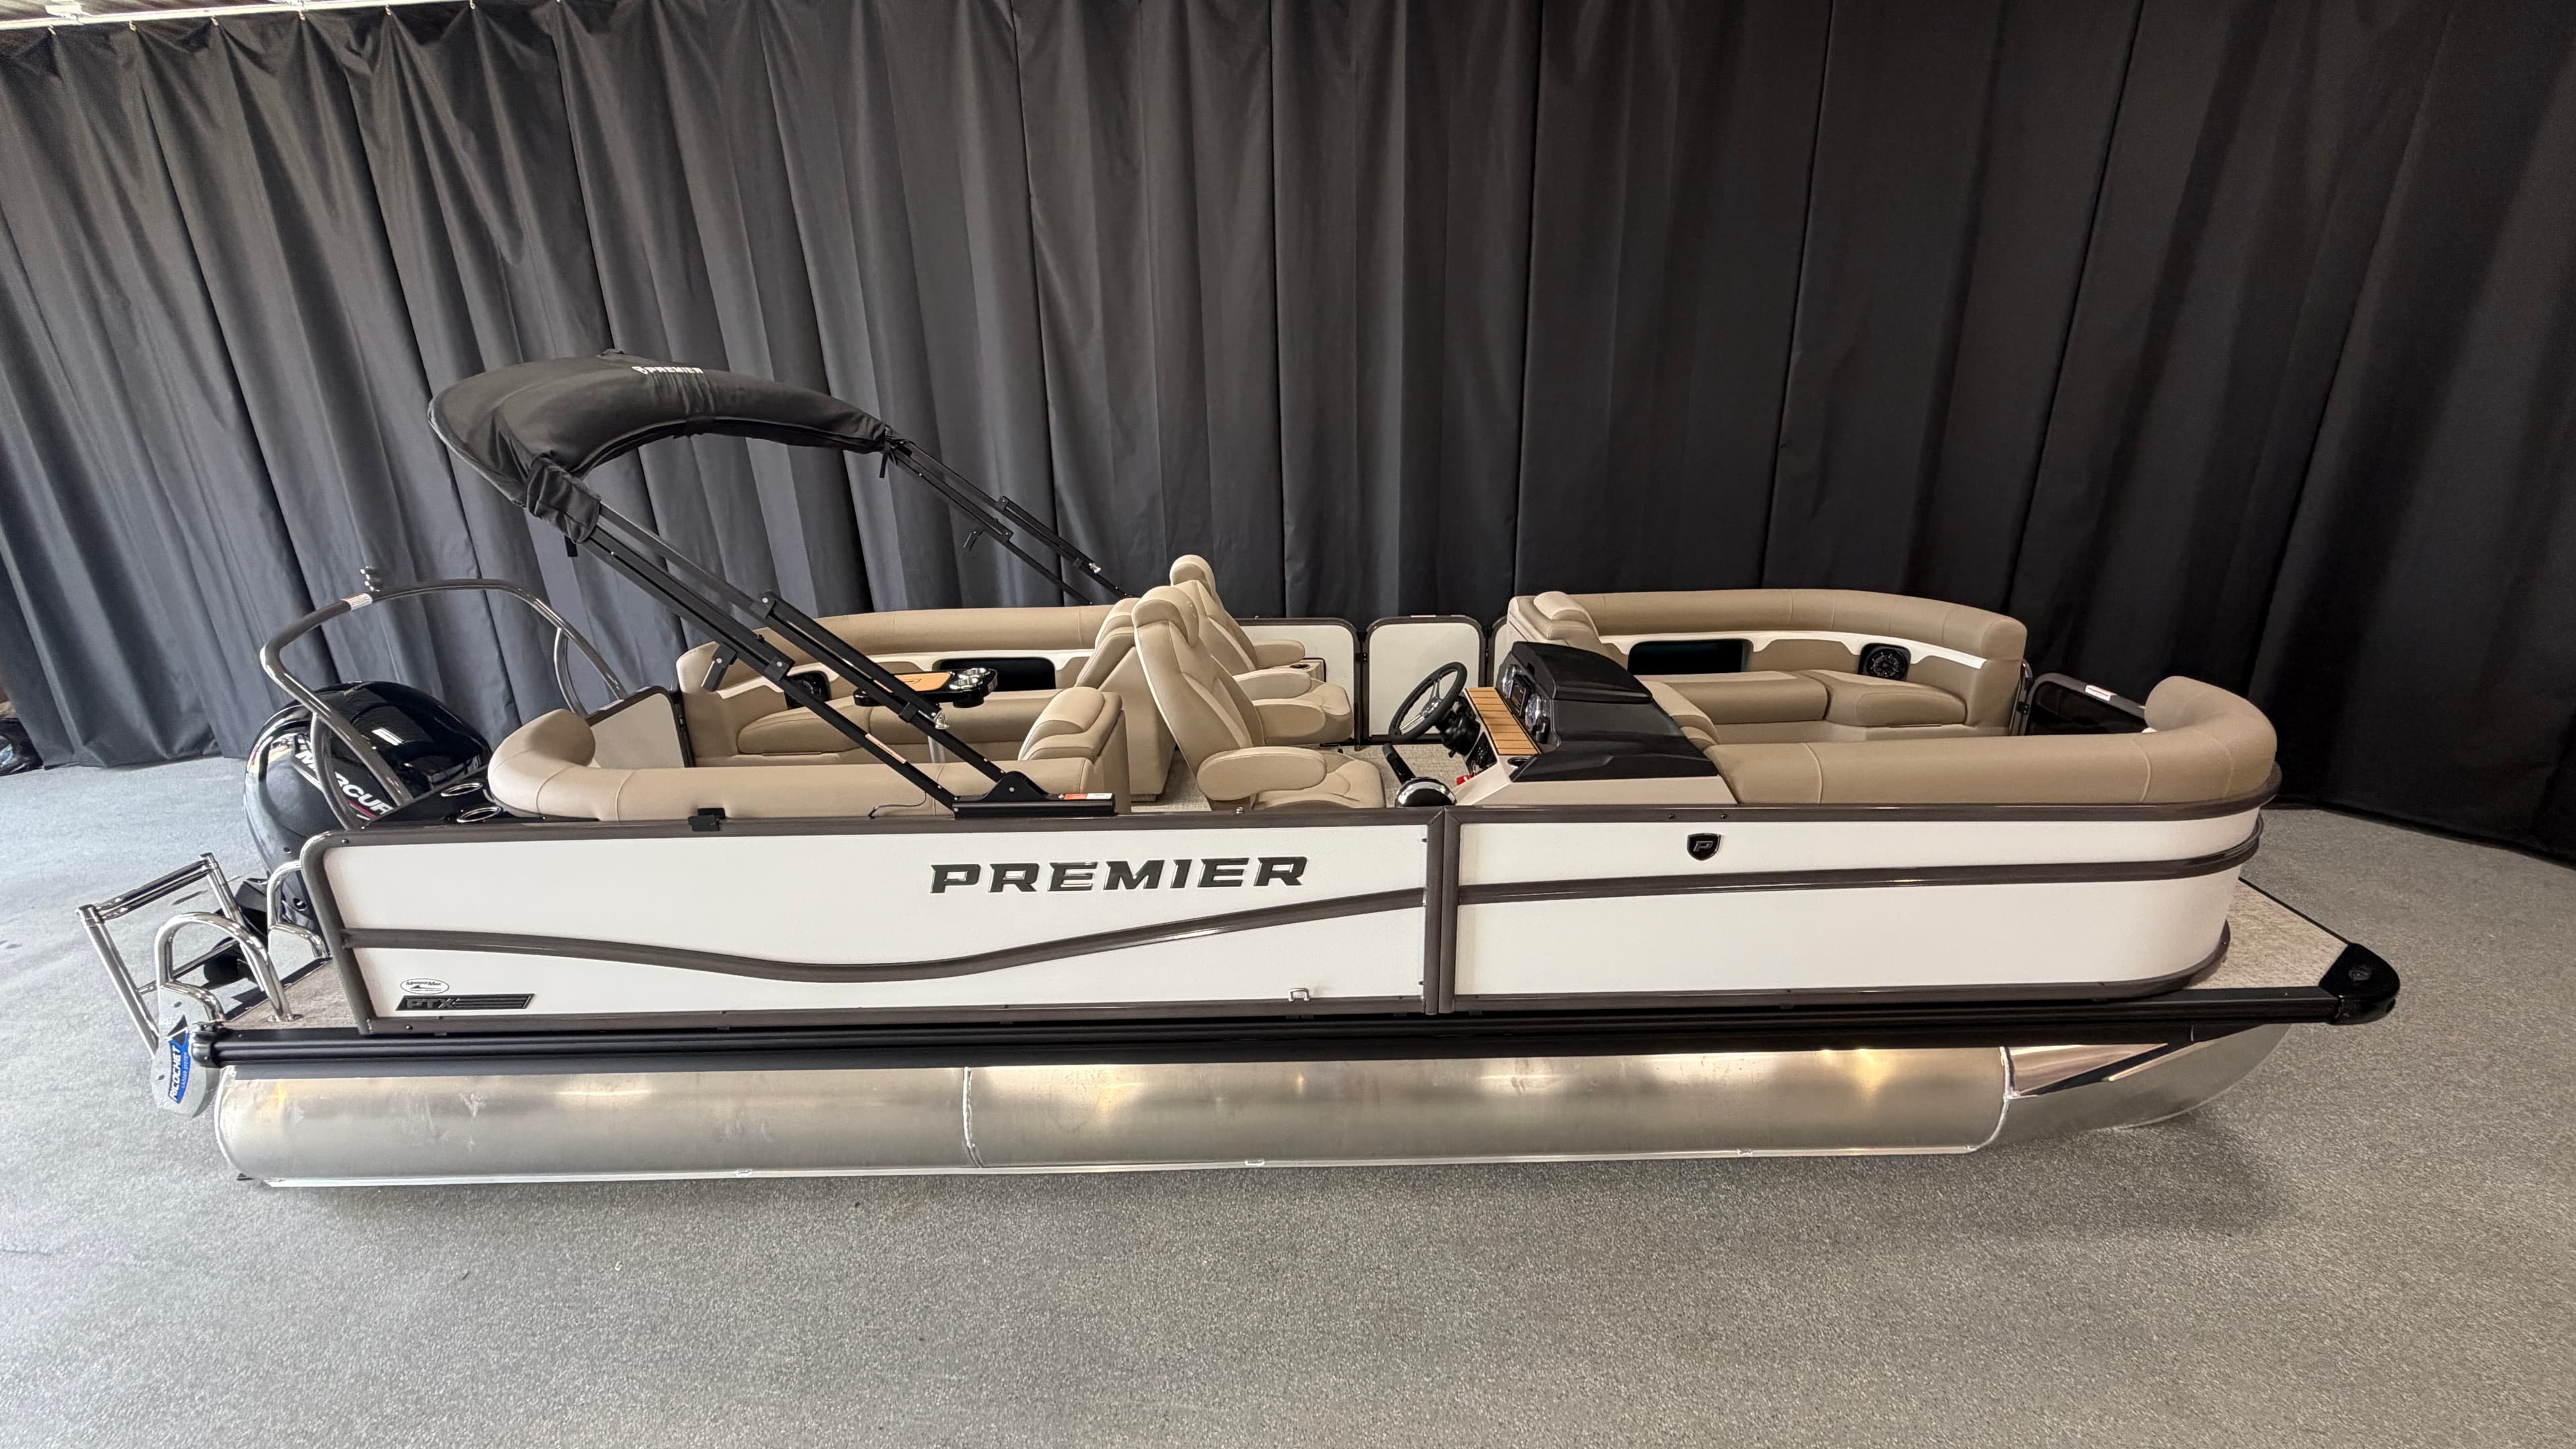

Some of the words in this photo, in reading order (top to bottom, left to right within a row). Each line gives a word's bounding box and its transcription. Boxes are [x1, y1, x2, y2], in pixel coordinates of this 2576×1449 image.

[295, 750, 394, 814] MRCUR
[930, 856, 1307, 894] PREMIER
[407, 998, 454, 1009] PTX
[170, 1046, 181, 1101] RICOCHET
